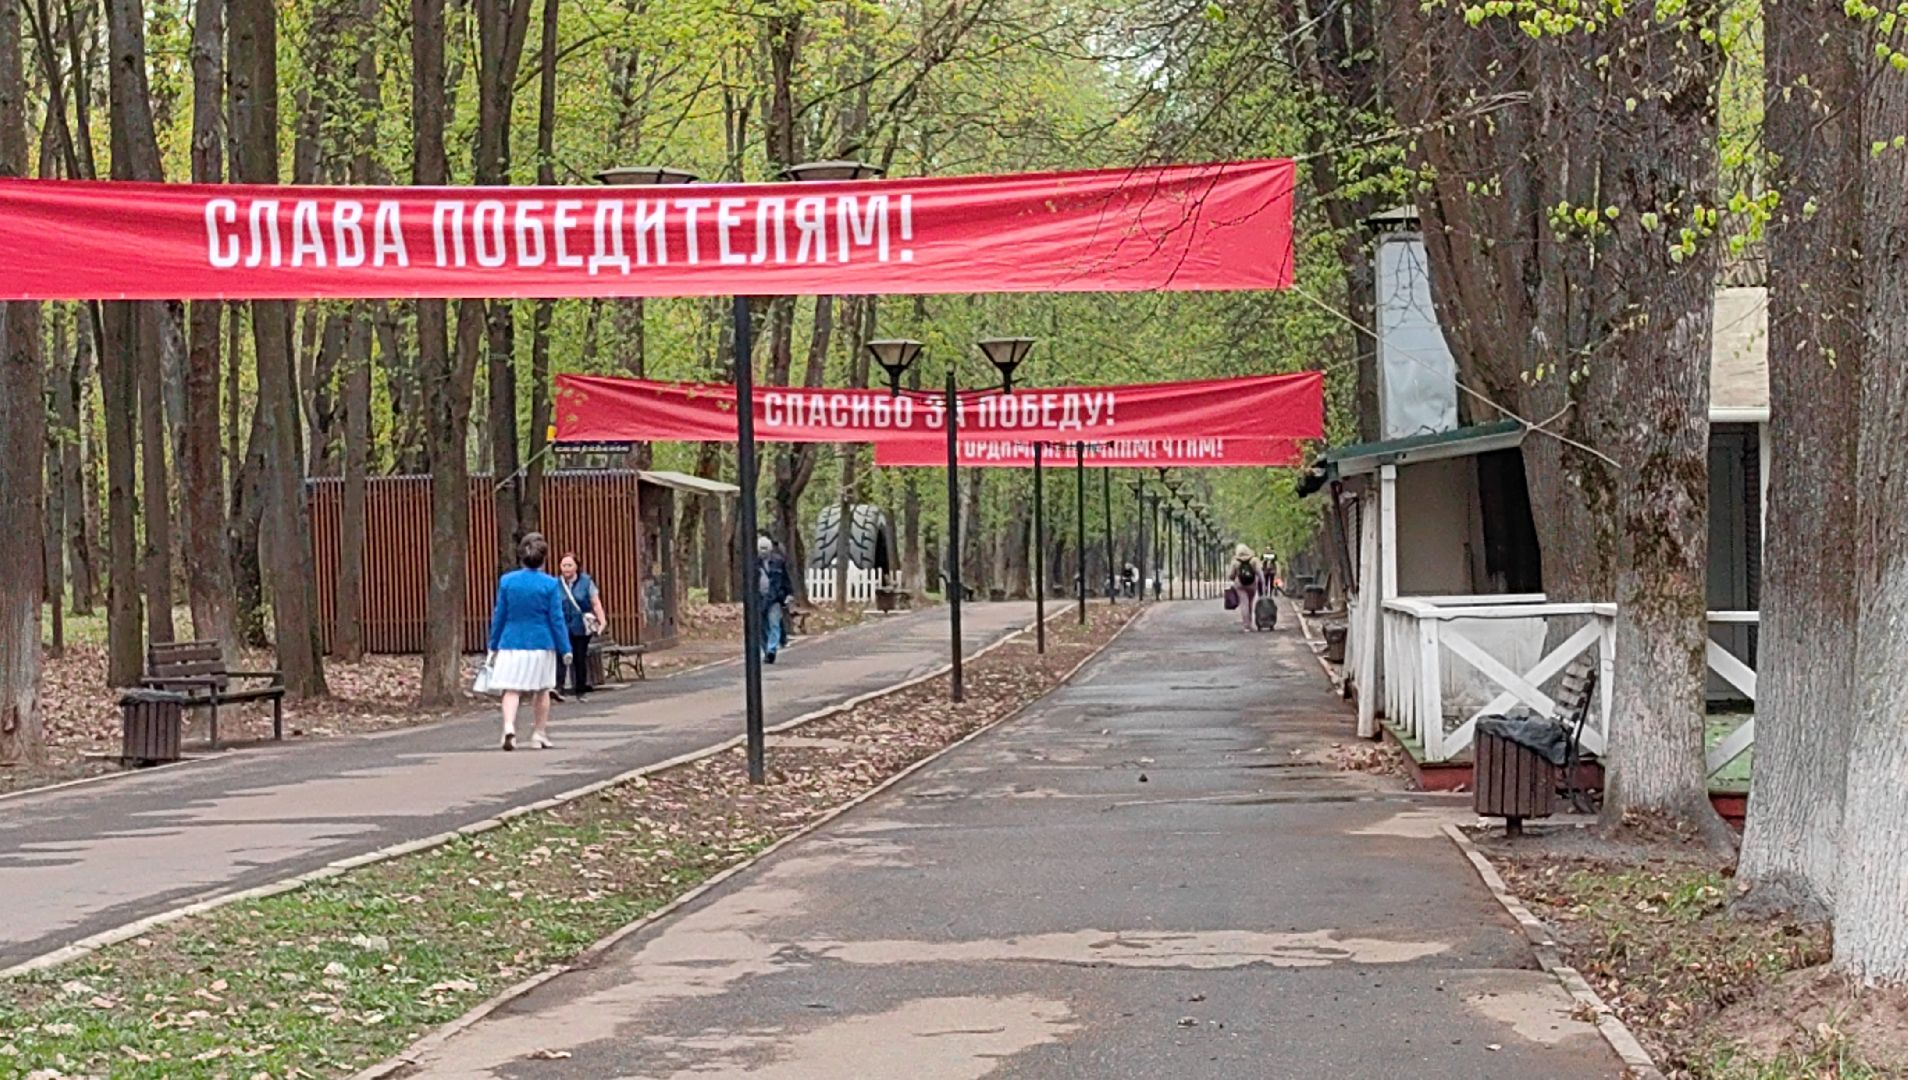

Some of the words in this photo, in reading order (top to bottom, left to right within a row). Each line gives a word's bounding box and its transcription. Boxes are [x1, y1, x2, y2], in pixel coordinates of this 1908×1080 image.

[203, 197, 410, 269] СЛАВА
[432, 193, 916, 276] ПОБЕДИТЕЛЯМ!
[763, 392, 913, 428] СПАСИБО
[978, 391, 1115, 432] ПОБЕДУ!
